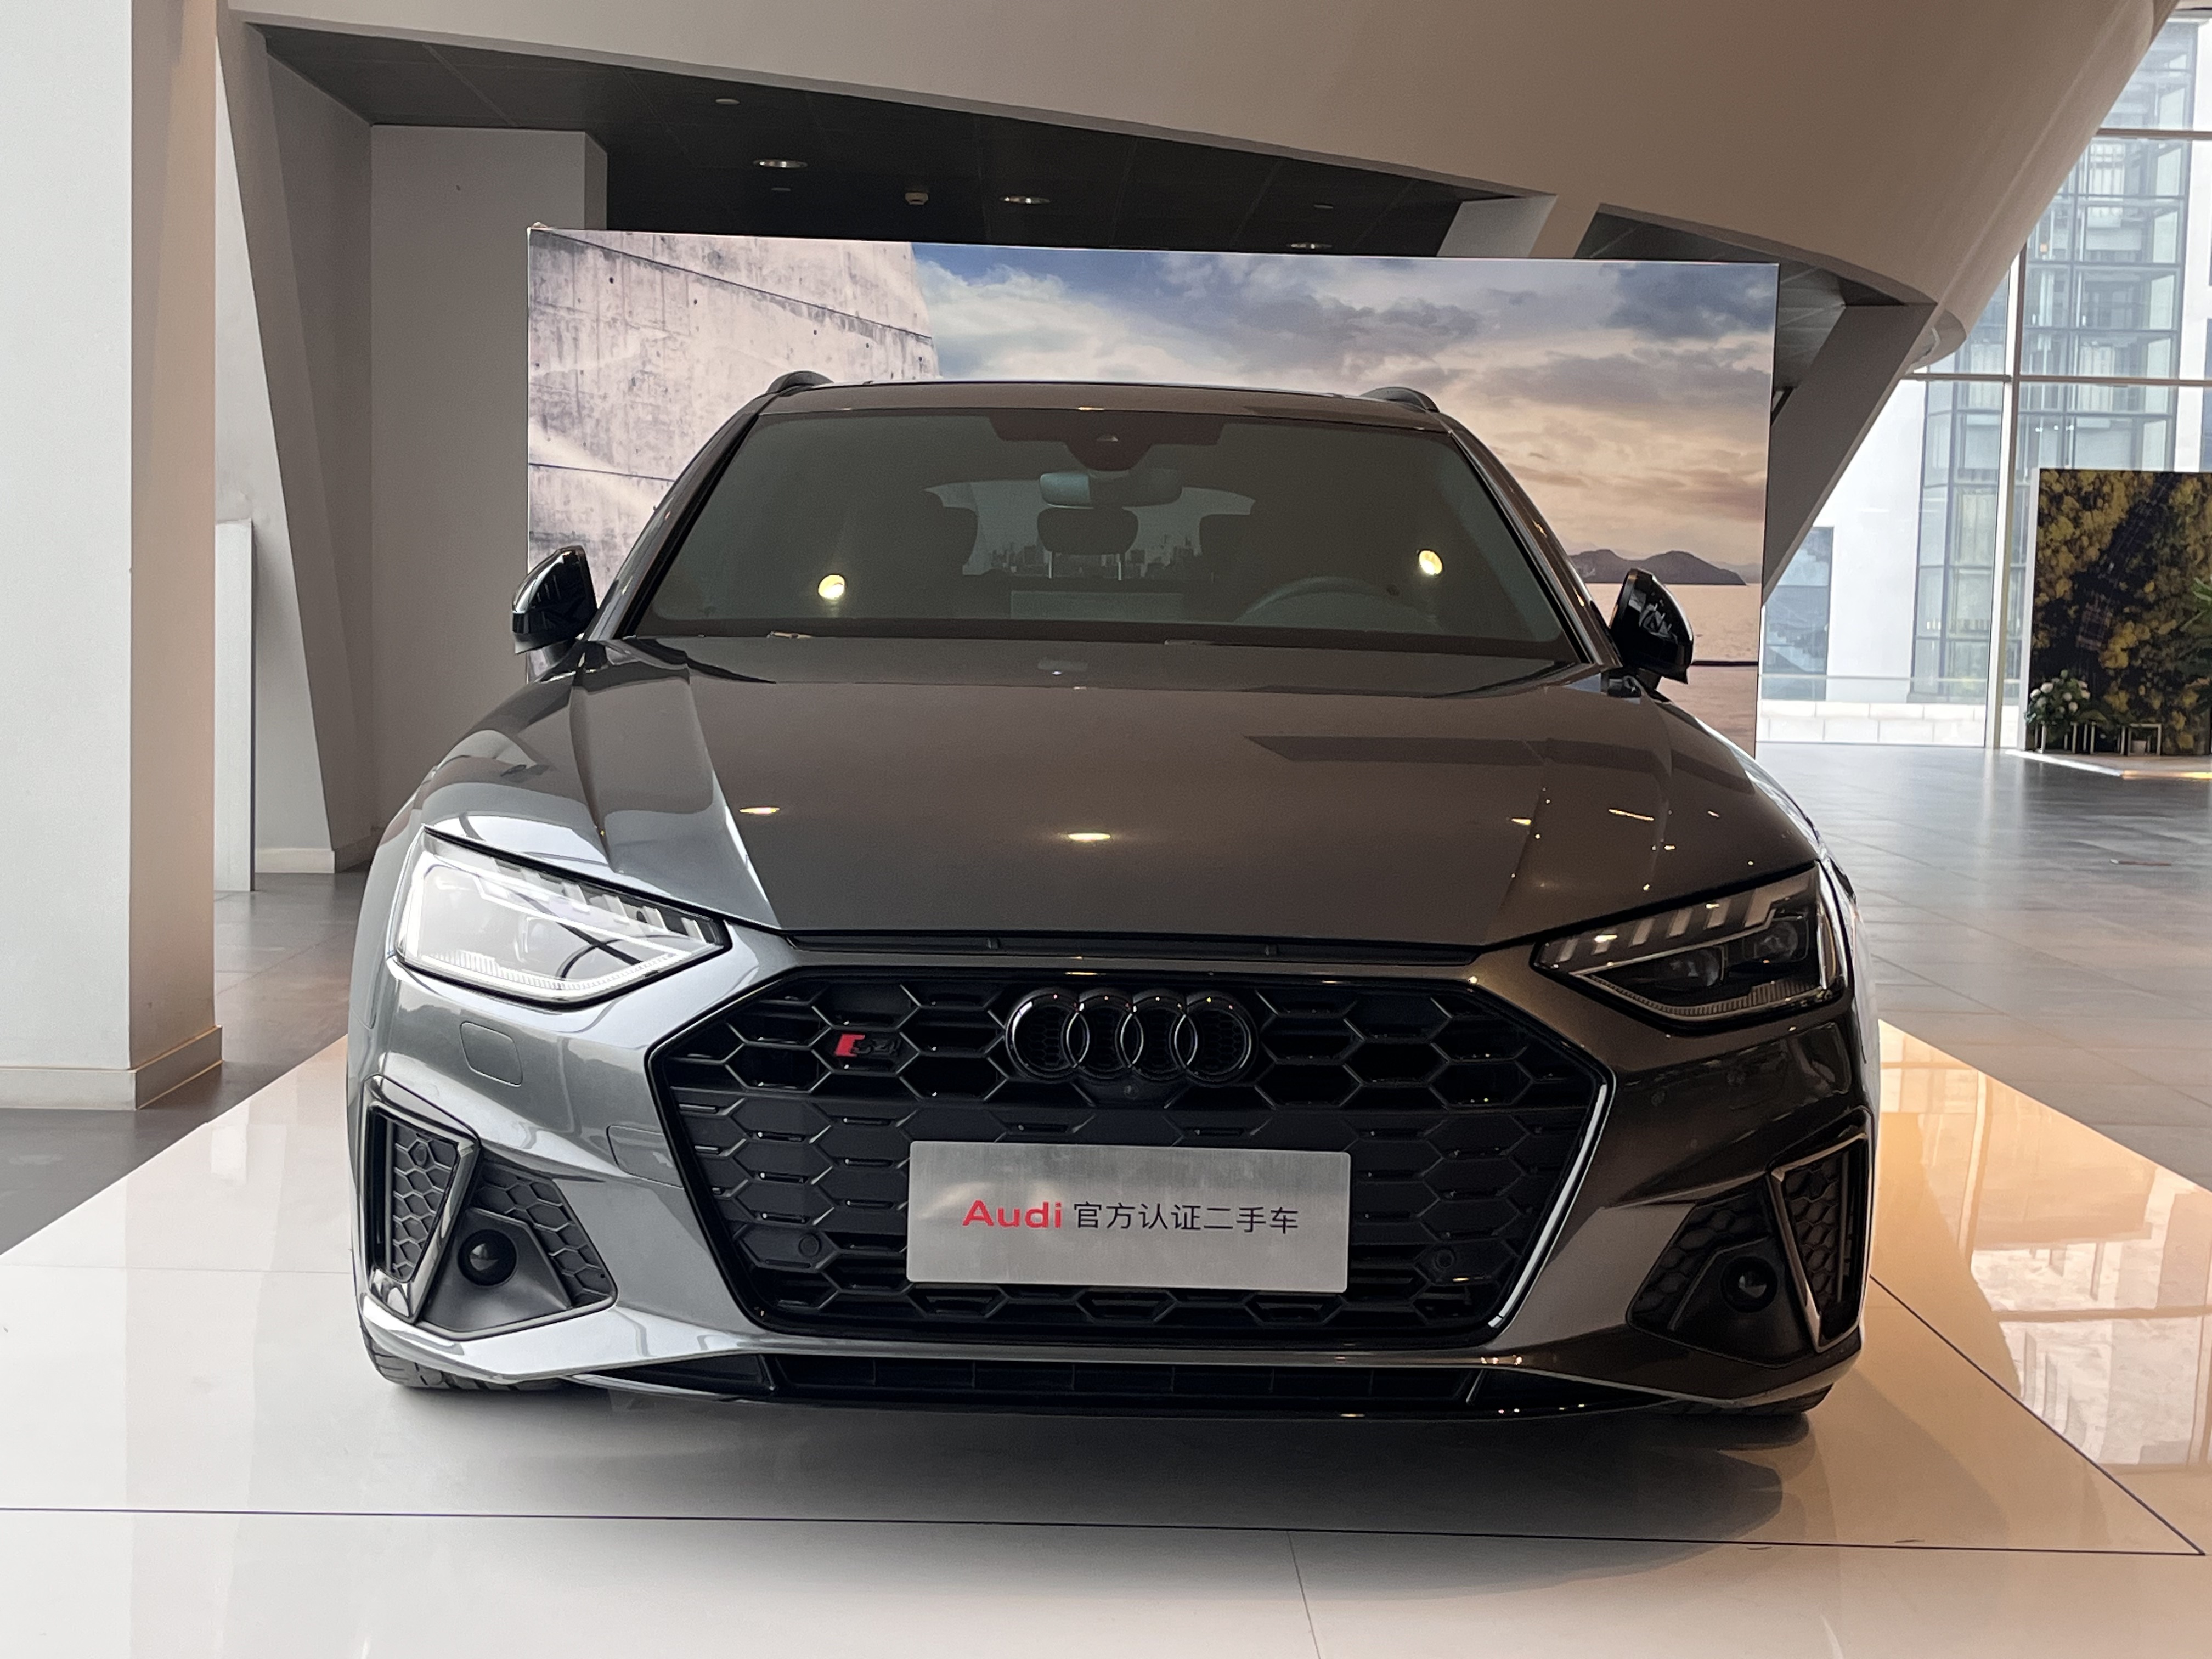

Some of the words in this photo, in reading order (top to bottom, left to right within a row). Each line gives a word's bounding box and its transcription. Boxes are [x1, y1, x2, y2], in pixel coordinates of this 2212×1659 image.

[962, 1199, 1062, 1228] Audi
[1073, 1201, 1299, 1234] 官方认证二手车
